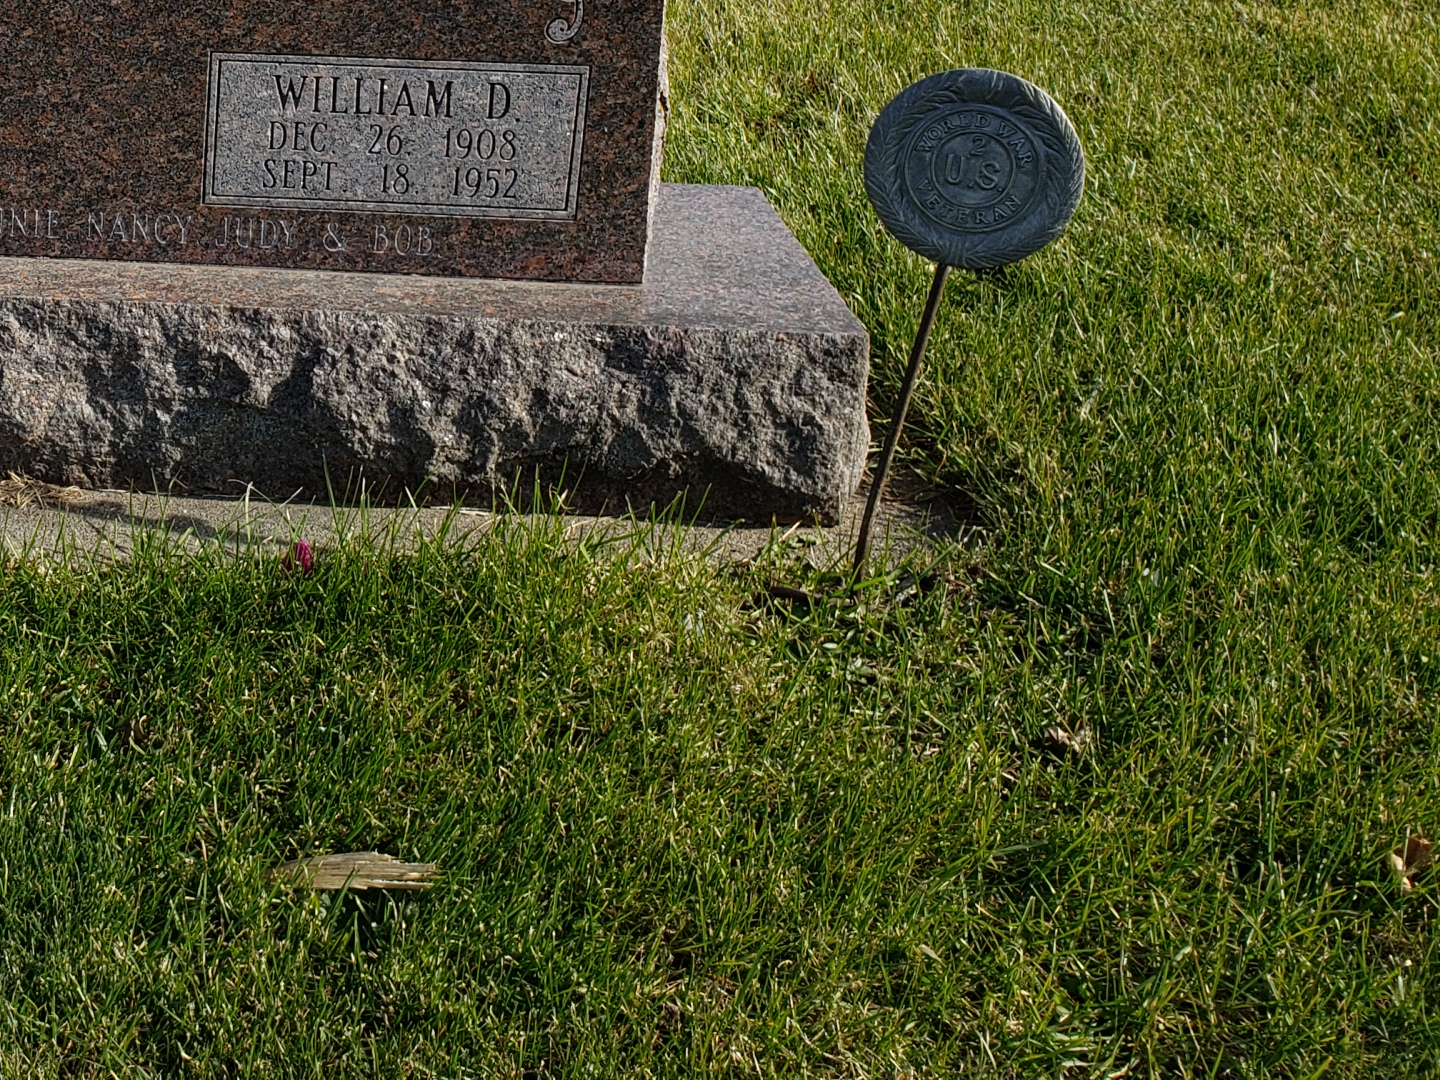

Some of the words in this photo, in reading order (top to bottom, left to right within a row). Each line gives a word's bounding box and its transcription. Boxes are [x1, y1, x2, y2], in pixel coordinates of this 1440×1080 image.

[273, 74, 454, 119] WILLIAM
[486, 81, 521, 123] D.
[268, 120, 336, 155] DEC.
[443, 127, 517, 161] 1908
[915, 113, 991, 155] WORLD
[998, 120, 1035, 168] WAR
[970, 135, 987, 156] 2
[262, 158, 348, 193] SEPT.
[451, 166, 519, 199] 1952
[944, 152, 1003, 192] U.S.
[917, 178, 1023, 226] VETERAN
[322, 221, 350, 252] &
[372, 223, 435, 257] BOB
